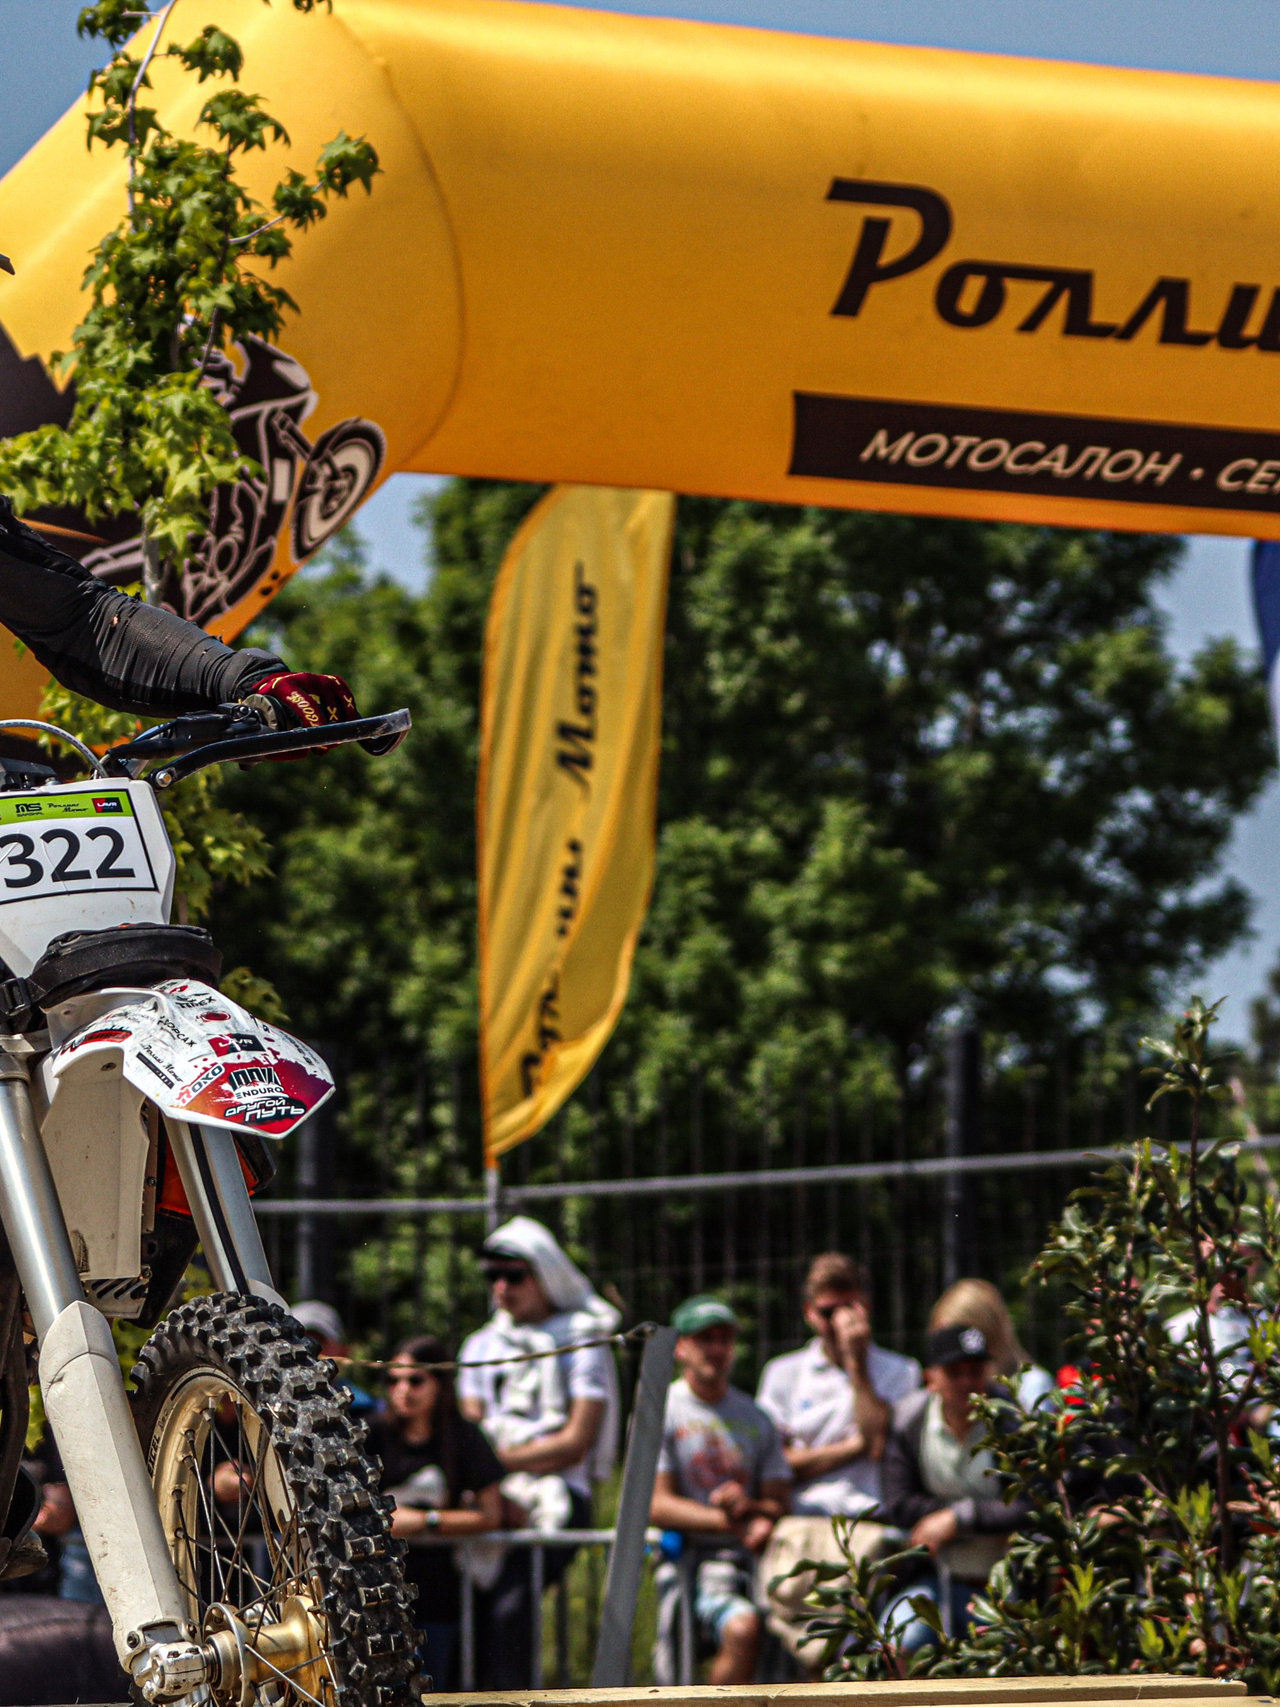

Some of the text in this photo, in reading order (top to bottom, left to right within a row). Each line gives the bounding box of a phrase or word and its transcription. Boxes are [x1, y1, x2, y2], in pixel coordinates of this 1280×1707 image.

[859, 428, 1280, 495] МОТОСАЛОН СЕ
[235, 1086, 283, 1099] ENDURO
[225, 1097, 286, 1117] ДРУГОЙ
[245, 1106, 306, 1122] ПУТЬ
